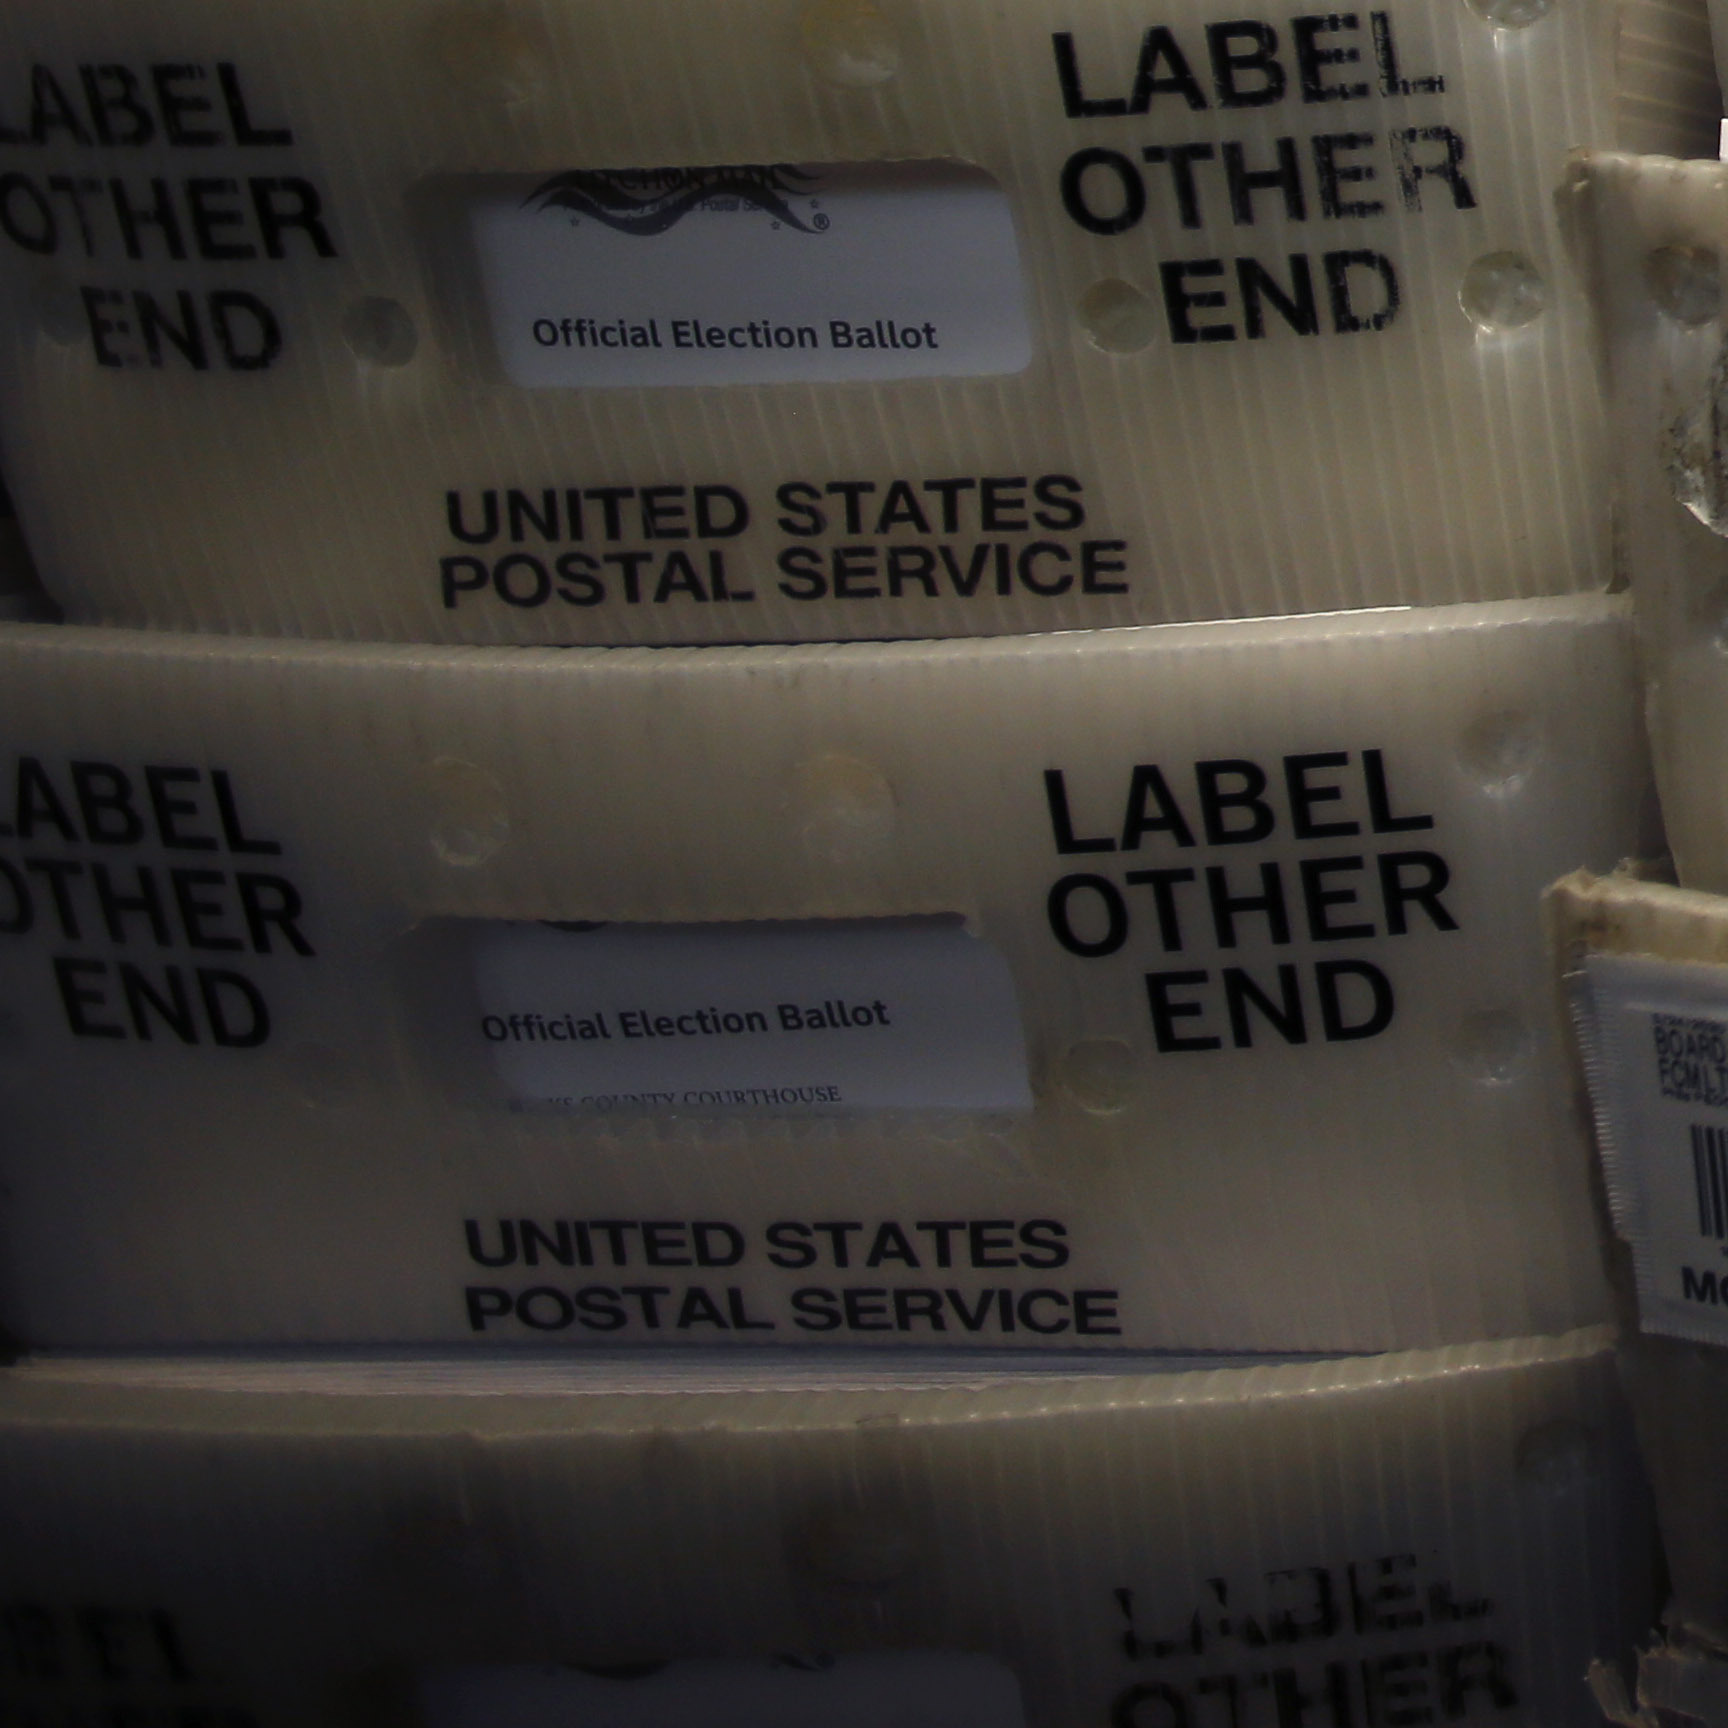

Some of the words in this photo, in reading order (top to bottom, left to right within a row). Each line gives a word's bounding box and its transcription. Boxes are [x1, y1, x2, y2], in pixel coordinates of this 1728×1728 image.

[1053, 12, 1445, 117] LABEL
[1060, 128, 1479, 233] OTHER
[533, 319, 662, 347] Official
[672, 320, 818, 349] Election
[830, 320, 939, 349] Ballot
[1163, 250, 1404, 345] END
[446, 484, 749, 544] UNITED
[777, 475, 1086, 537] STATES
[440, 548, 755, 610] POSTAL
[779, 540, 1131, 600] SERVICE
[1043, 749, 1433, 855] LABEL
[1046, 850, 1459, 957] OTHER
[482, 1012, 610, 1042] Official
[620, 1007, 769, 1040] Election
[778, 999, 890, 1031] Ballot
[1146, 958, 1396, 1053] END
[465, 1220, 745, 1269] UNITED
[767, 1220, 1071, 1270] STATES
[466, 1287, 774, 1332] POSTAL
[793, 1287, 1121, 1336] SERVICE
